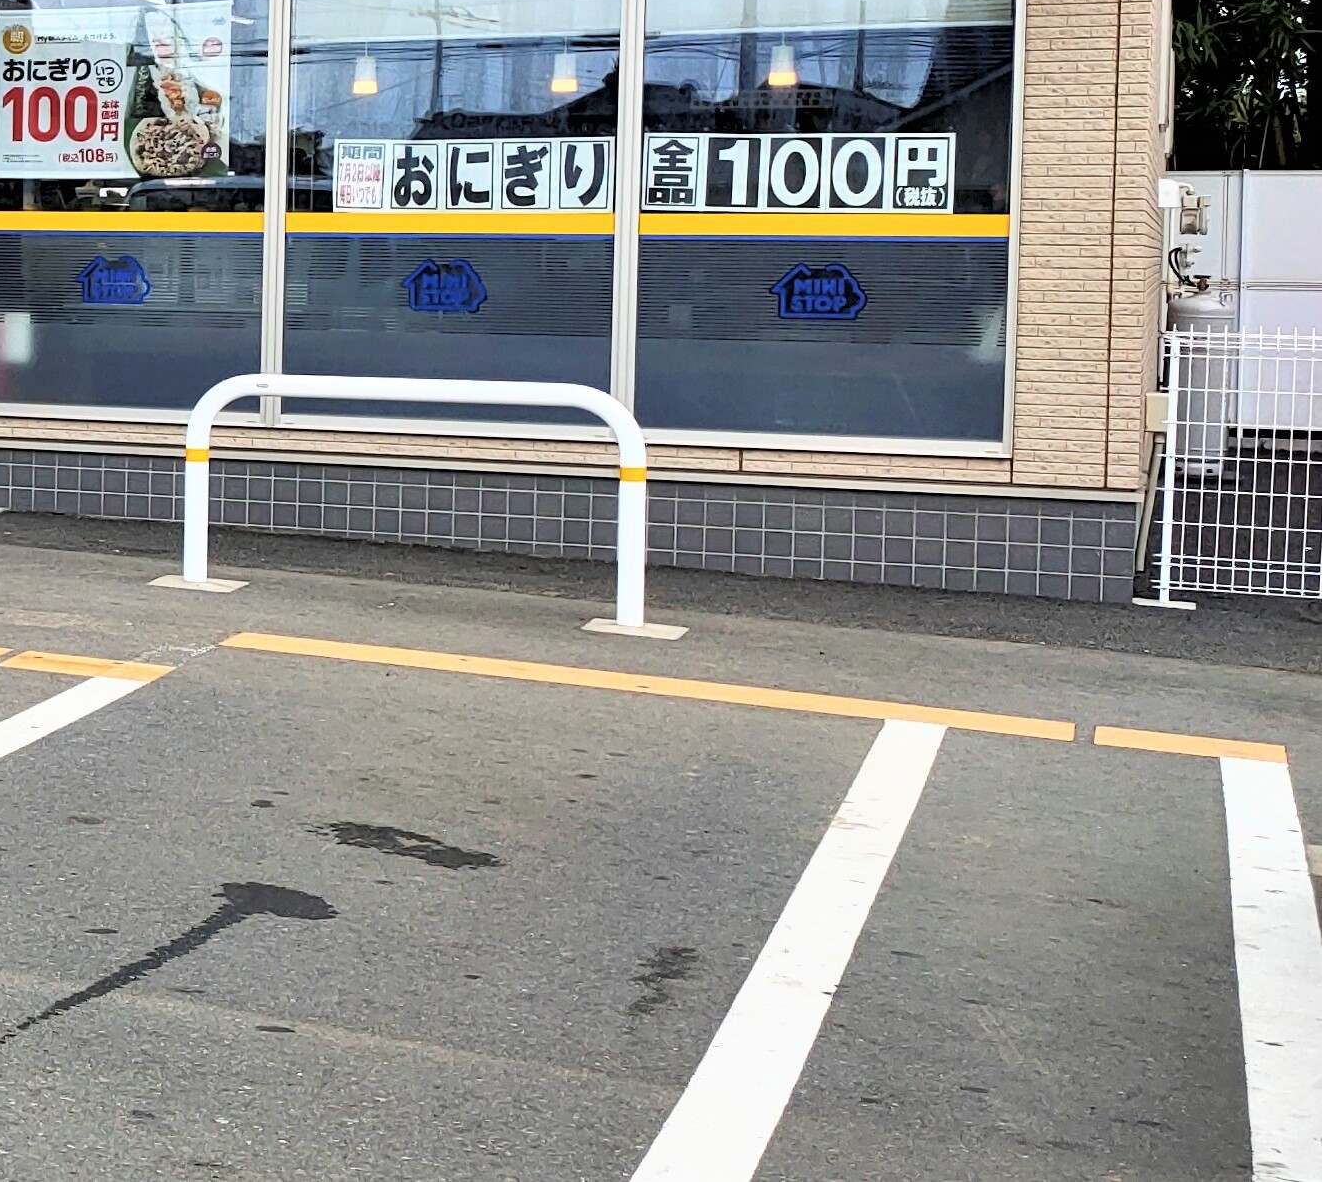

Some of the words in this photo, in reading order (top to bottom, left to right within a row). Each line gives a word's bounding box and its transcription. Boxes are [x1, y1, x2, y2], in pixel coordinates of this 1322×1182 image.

[2, 58, 91, 82] おにぎり
[95, 66, 114, 76] いつ
[96, 77, 115, 87] でも
[2, 86, 98, 142] 100
[101, 122, 119, 142] 円
[394, 144, 605, 207] おにぎり
[895, 187, 945, 206] (税抜)
[794, 279, 844, 295] MINI
[791, 295, 846, 312] STOP
